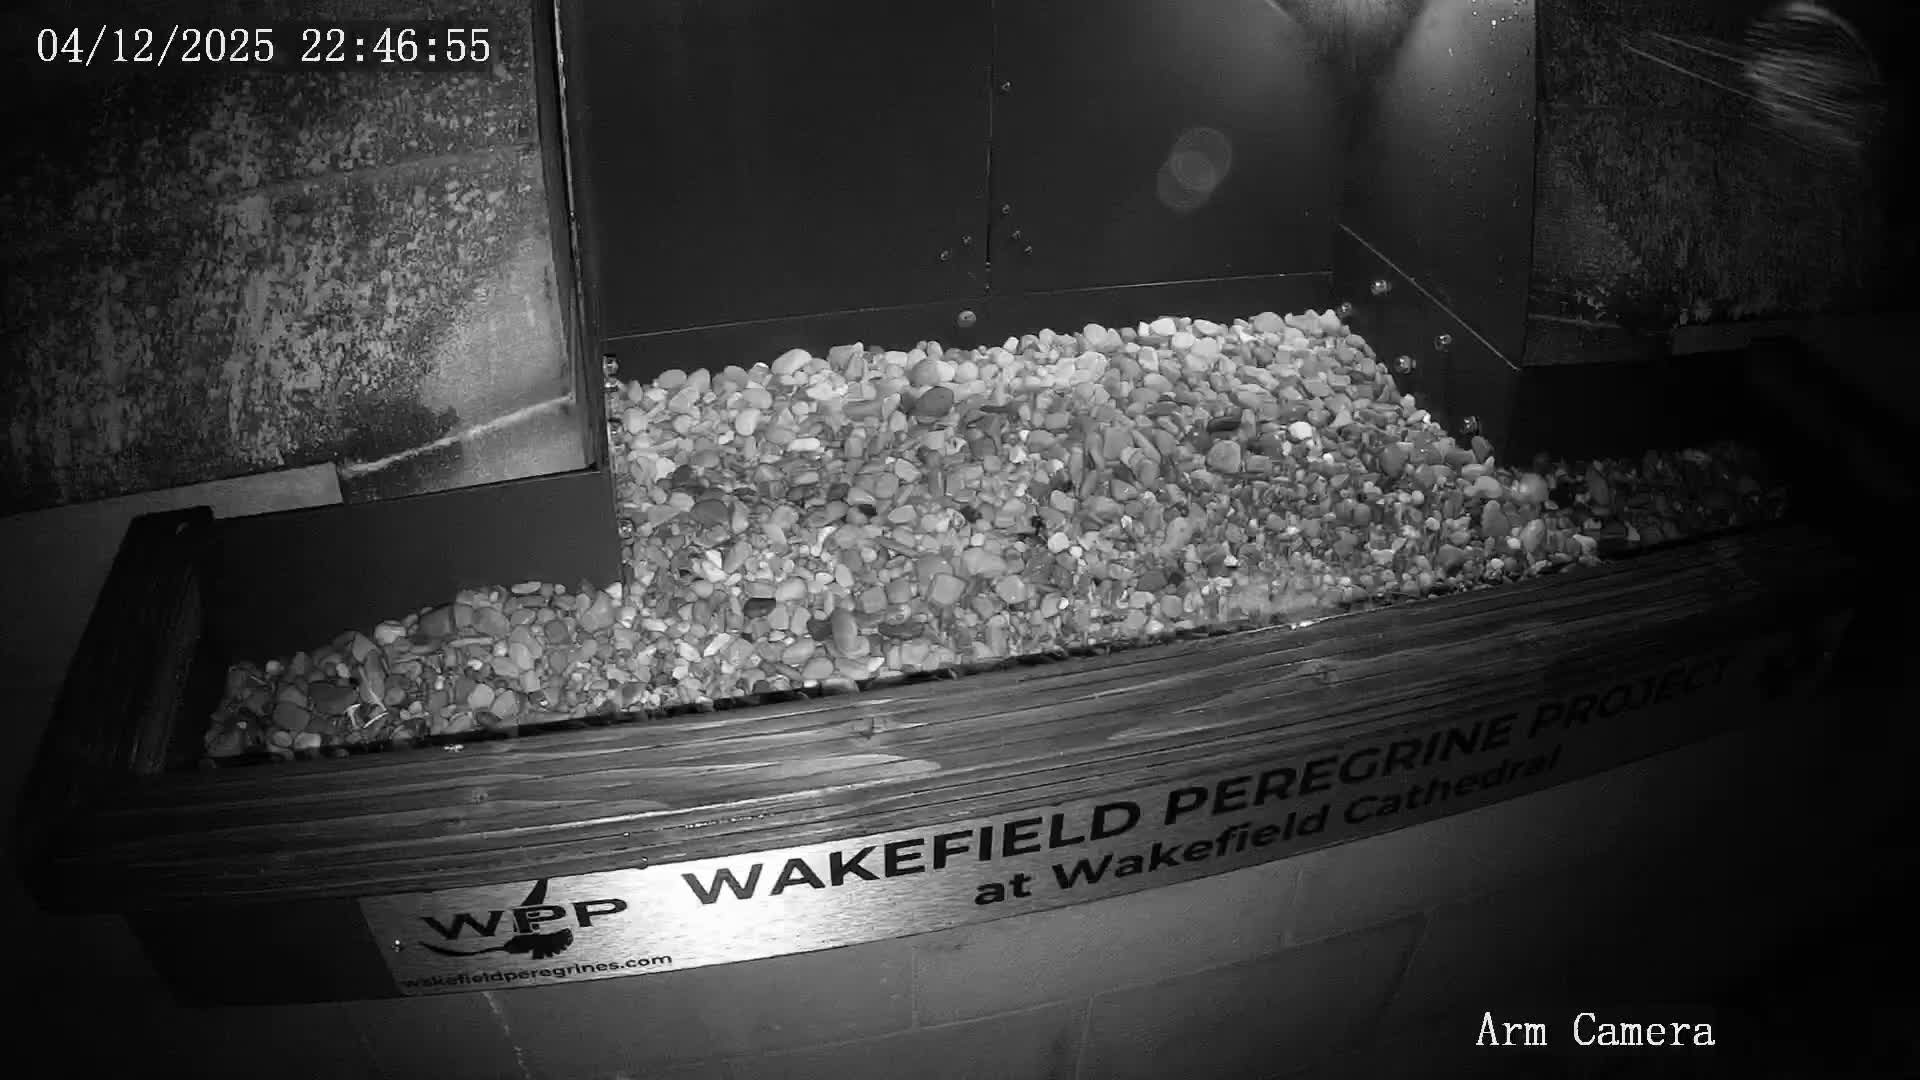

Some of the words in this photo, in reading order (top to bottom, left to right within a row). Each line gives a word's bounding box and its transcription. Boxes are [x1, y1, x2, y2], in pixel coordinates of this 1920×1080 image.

[681, 802, 1140, 905] WAKEFIELD
[1165, 712, 1518, 825] PEREGRINE
[974, 872, 1032, 905] at
[1053, 805, 1330, 889] Wakefield
[1344, 744, 1562, 824] Cathedral
[420, 898, 628, 941] WPP
